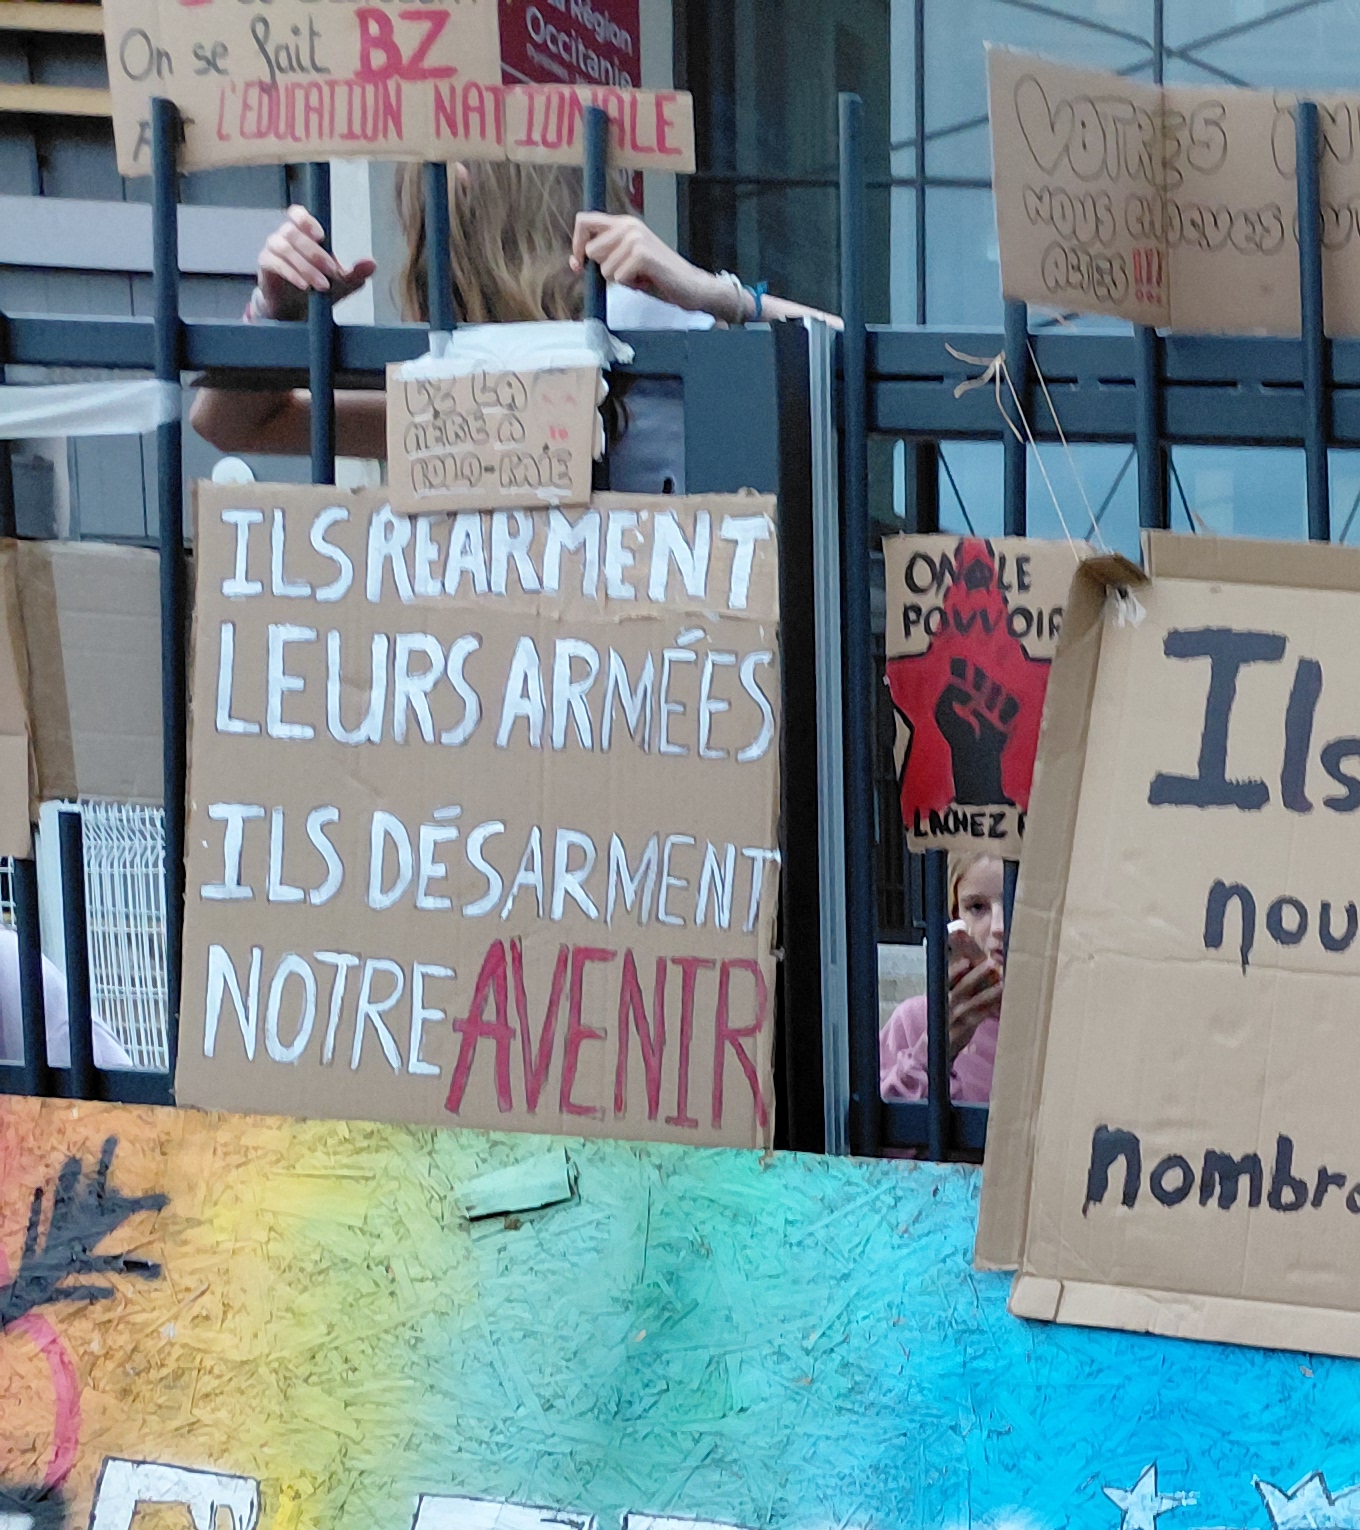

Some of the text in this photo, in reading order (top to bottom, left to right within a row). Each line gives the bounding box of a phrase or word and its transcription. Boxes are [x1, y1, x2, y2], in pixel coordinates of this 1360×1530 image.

[119, 27, 175, 81] On
[193, 41, 229, 76] se
[250, 13, 331, 91] fait
[353, 6, 459, 82] BZ
[526, 5, 633, 88] Occitanie
[220, 505, 355, 602] ILS
[215, 621, 776, 763] LEURS ARMÉES
[200, 801, 781, 933] ILS DÉSARMENT
[203, 935, 769, 1130] NOTRE AVENIR
